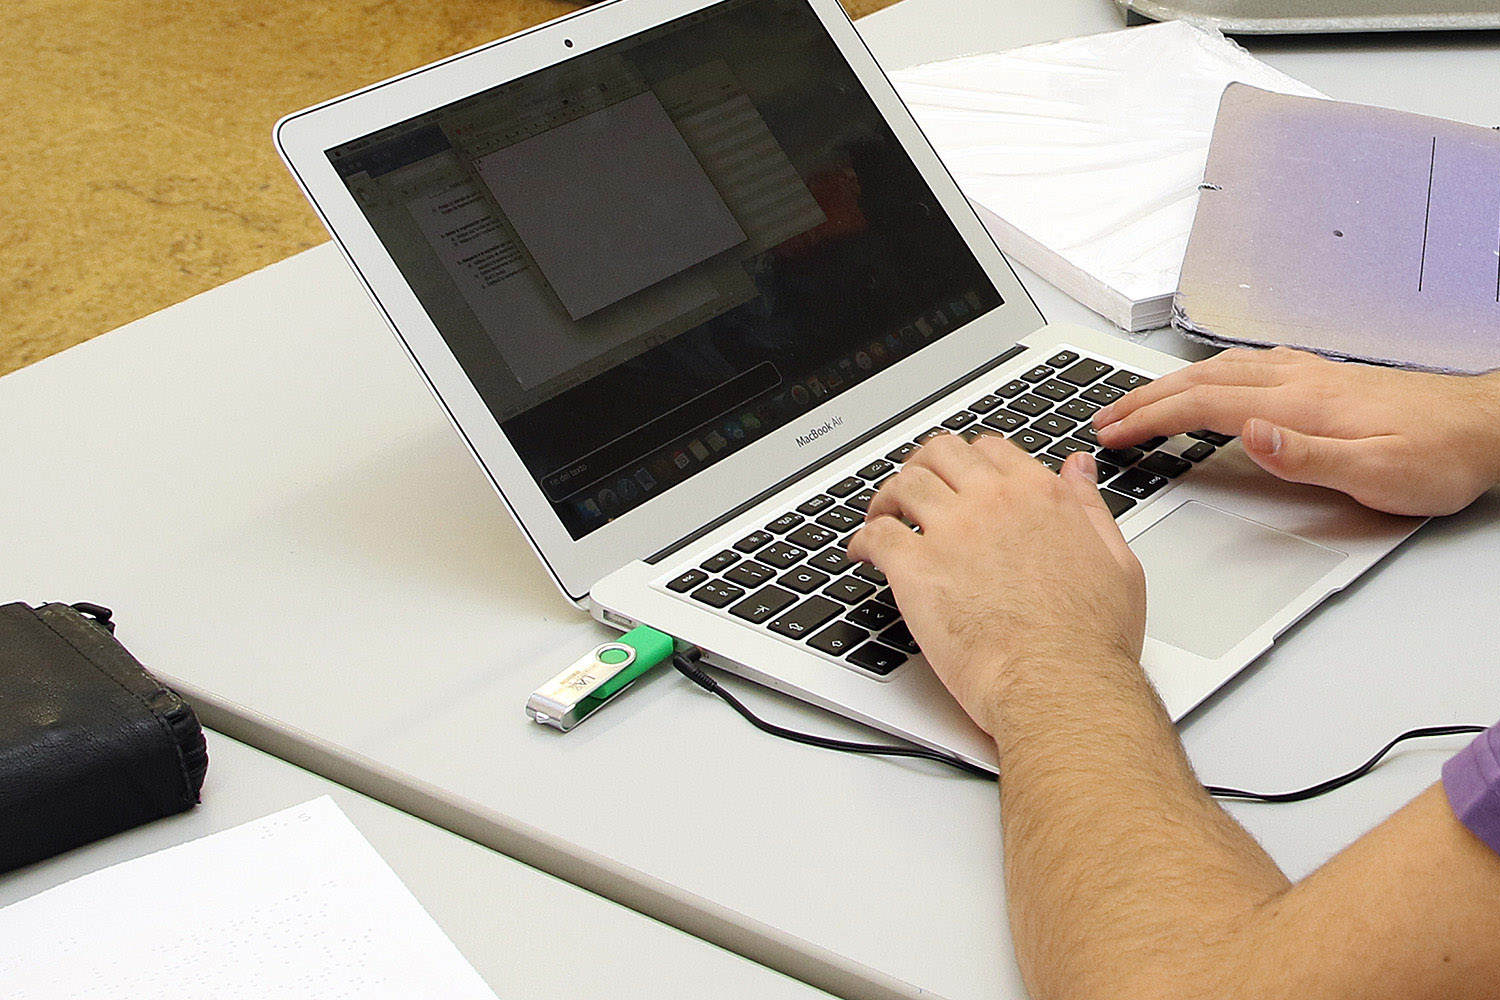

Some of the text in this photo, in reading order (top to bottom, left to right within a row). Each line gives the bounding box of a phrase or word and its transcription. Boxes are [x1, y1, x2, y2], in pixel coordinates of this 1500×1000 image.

[795, 416, 844, 448] MacBook Air
[844, 584, 858, 593] A
